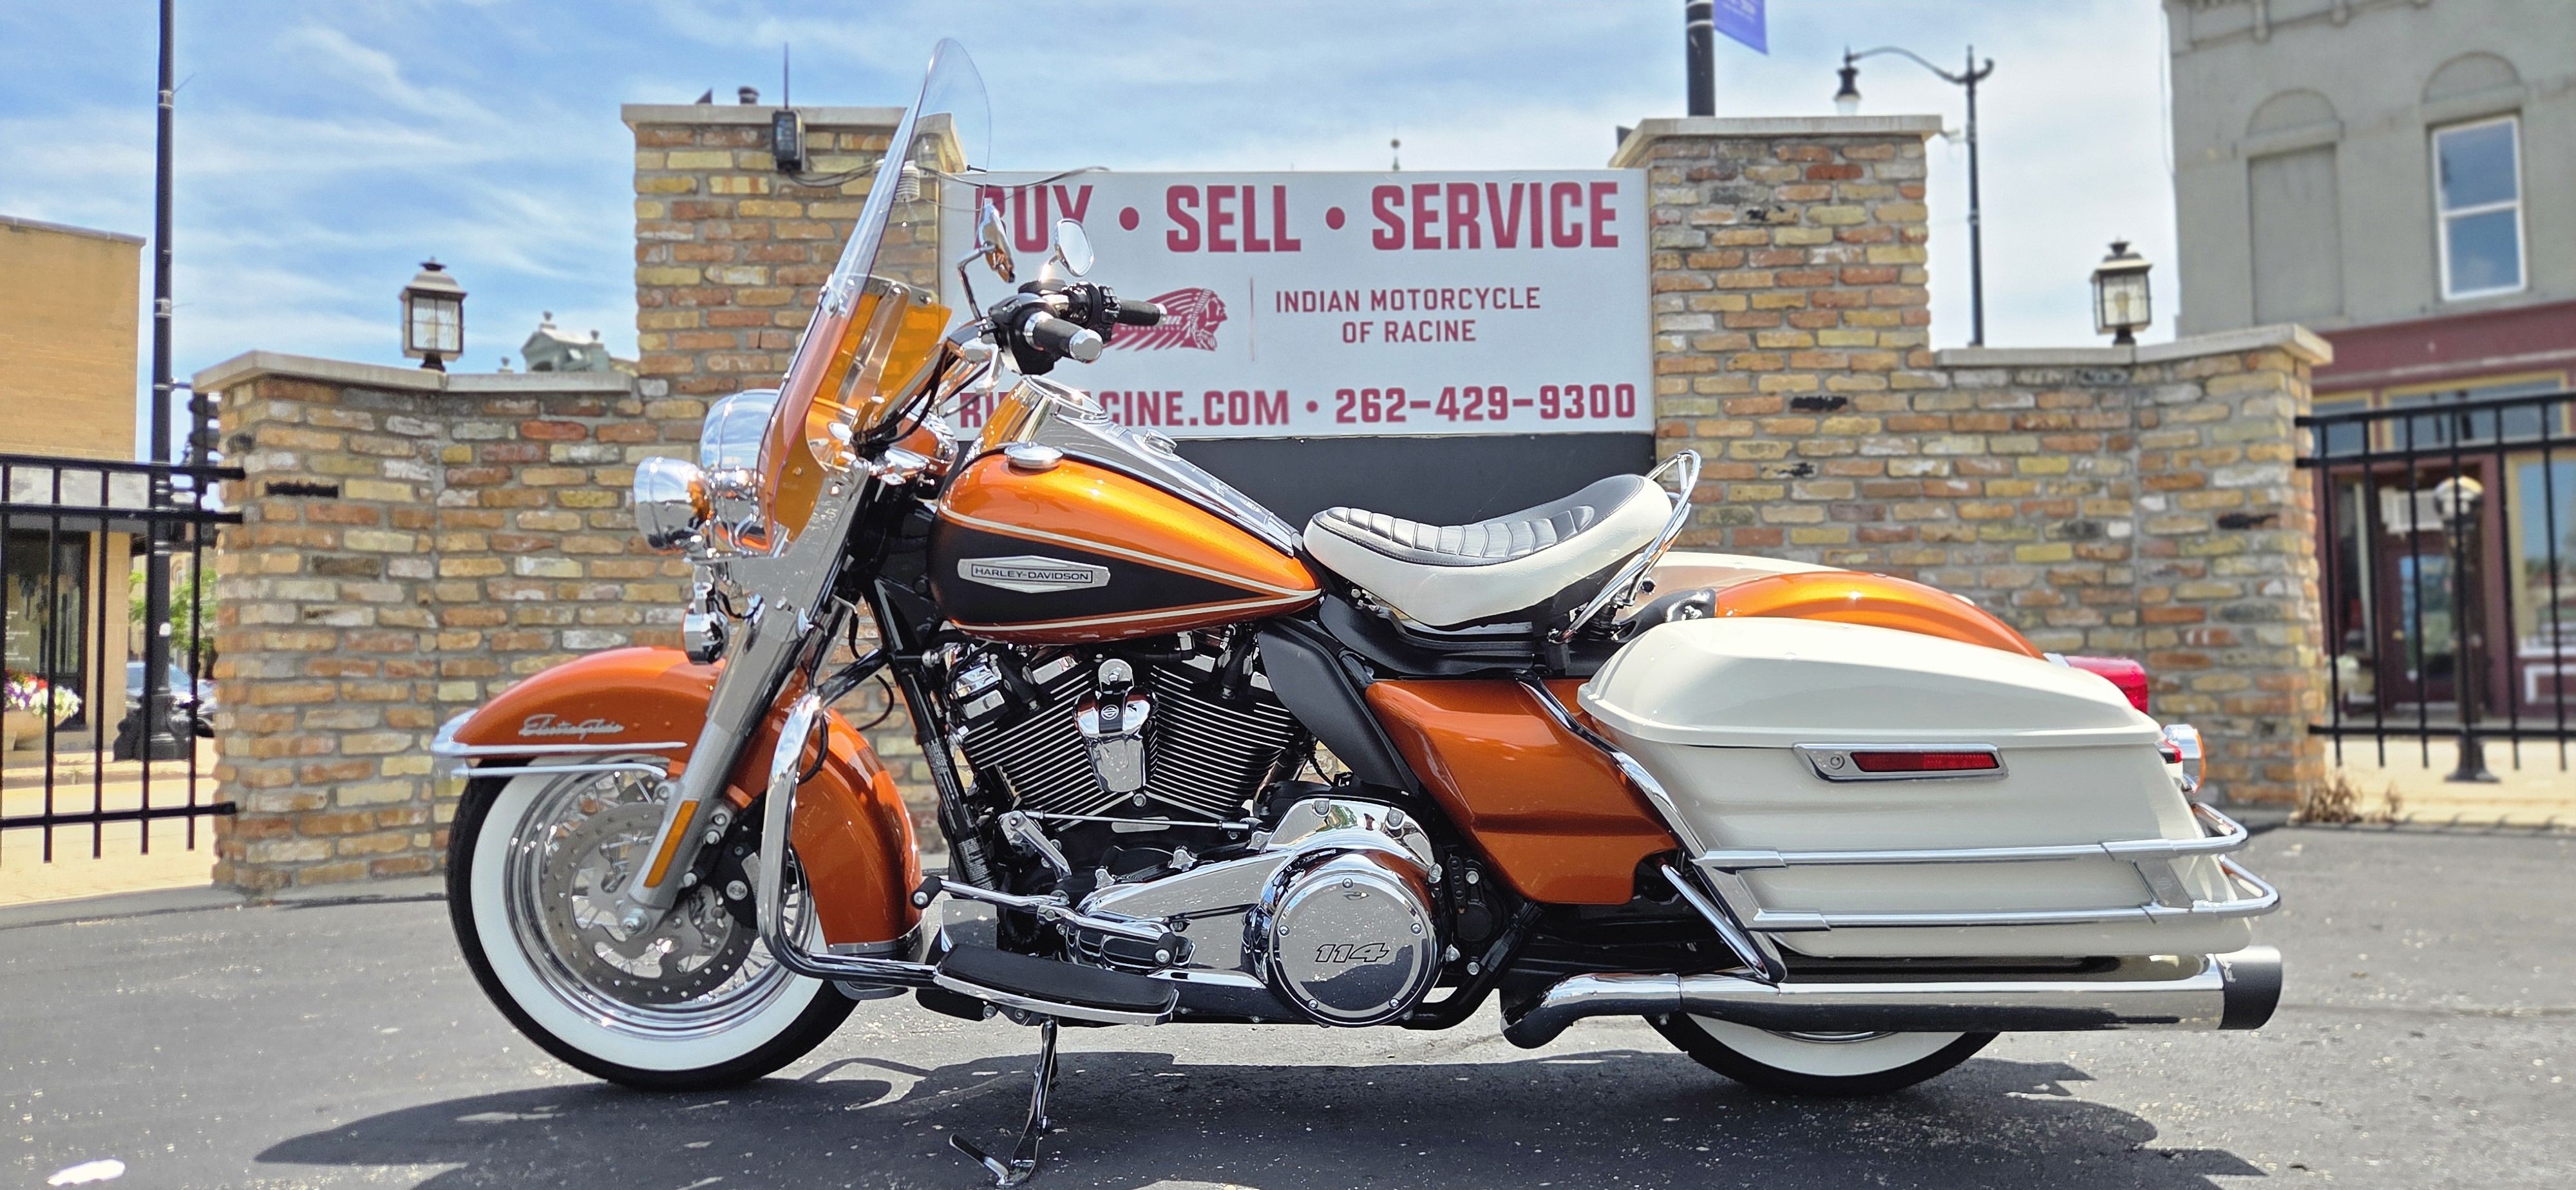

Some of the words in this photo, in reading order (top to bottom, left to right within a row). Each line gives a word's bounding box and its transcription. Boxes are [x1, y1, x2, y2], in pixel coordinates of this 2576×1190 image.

[1166, 184, 1302, 252] SELL
[1372, 182, 1618, 250] SERVICE
[1276, 290, 1359, 314] INDIAN
[1370, 287, 1540, 311] MOTORCYCLE
[1342, 323, 1372, 343] OF
[1385, 320, 1475, 343] RACINE
[960, 390, 1288, 428] RICINE.COM
[1336, 384, 1636, 424] 262-429-9300
[975, 567, 1089, 580] HARLEY-DAVIDSON
[1315, 943, 1390, 963] 114
